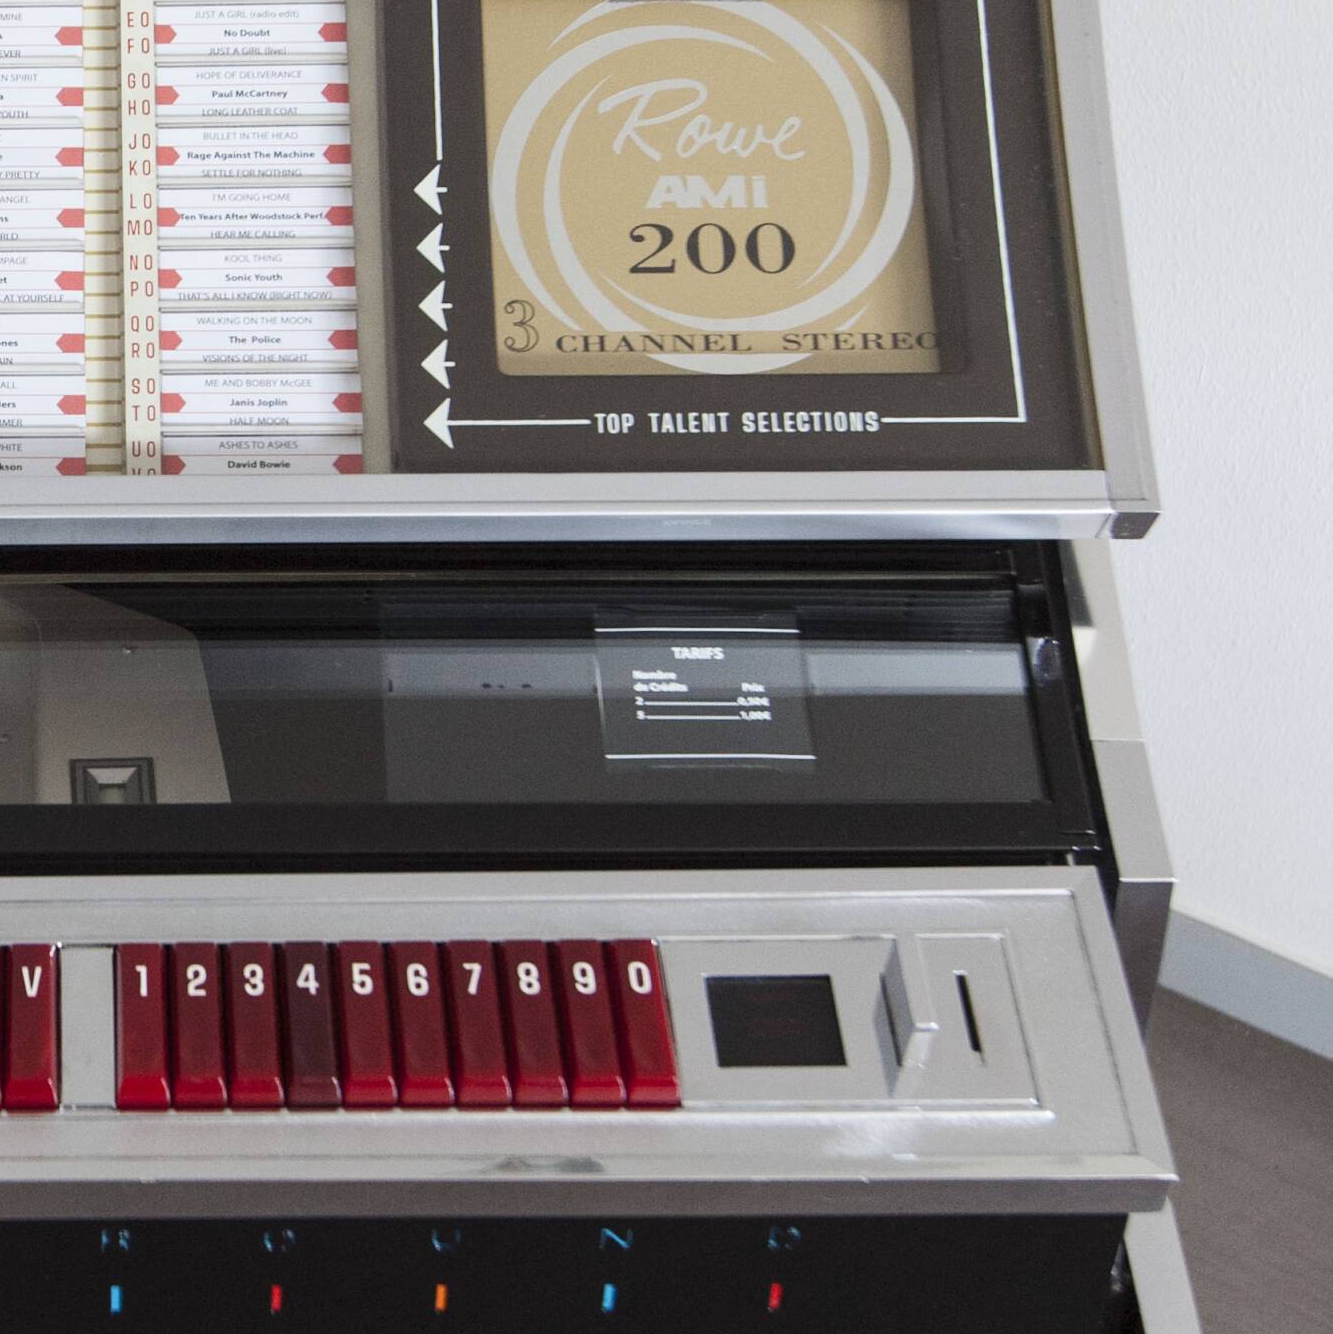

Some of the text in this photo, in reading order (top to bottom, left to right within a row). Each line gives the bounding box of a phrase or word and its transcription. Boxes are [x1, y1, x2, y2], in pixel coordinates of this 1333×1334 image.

[211, 89, 288, 99] Paul McCartney
[597, 77, 806, 163] Rowe
[628, 221, 797, 275] 200
[503, 298, 541, 354] 3
[555, 332, 753, 354] CHANNEL
[230, 397, 288, 409] Janis Joplin
[593, 410, 881, 435] TOP TALENT SELECTIONS
[218, 440, 299, 450] ASHES TO ASHES
[227, 460, 291, 469] David Bowie
[670, 646, 726, 661] TARIFS
[21, 965, 43, 998] V
[135, 961, 652, 997] 1 2 3 4 5 6 7 8 9 0
